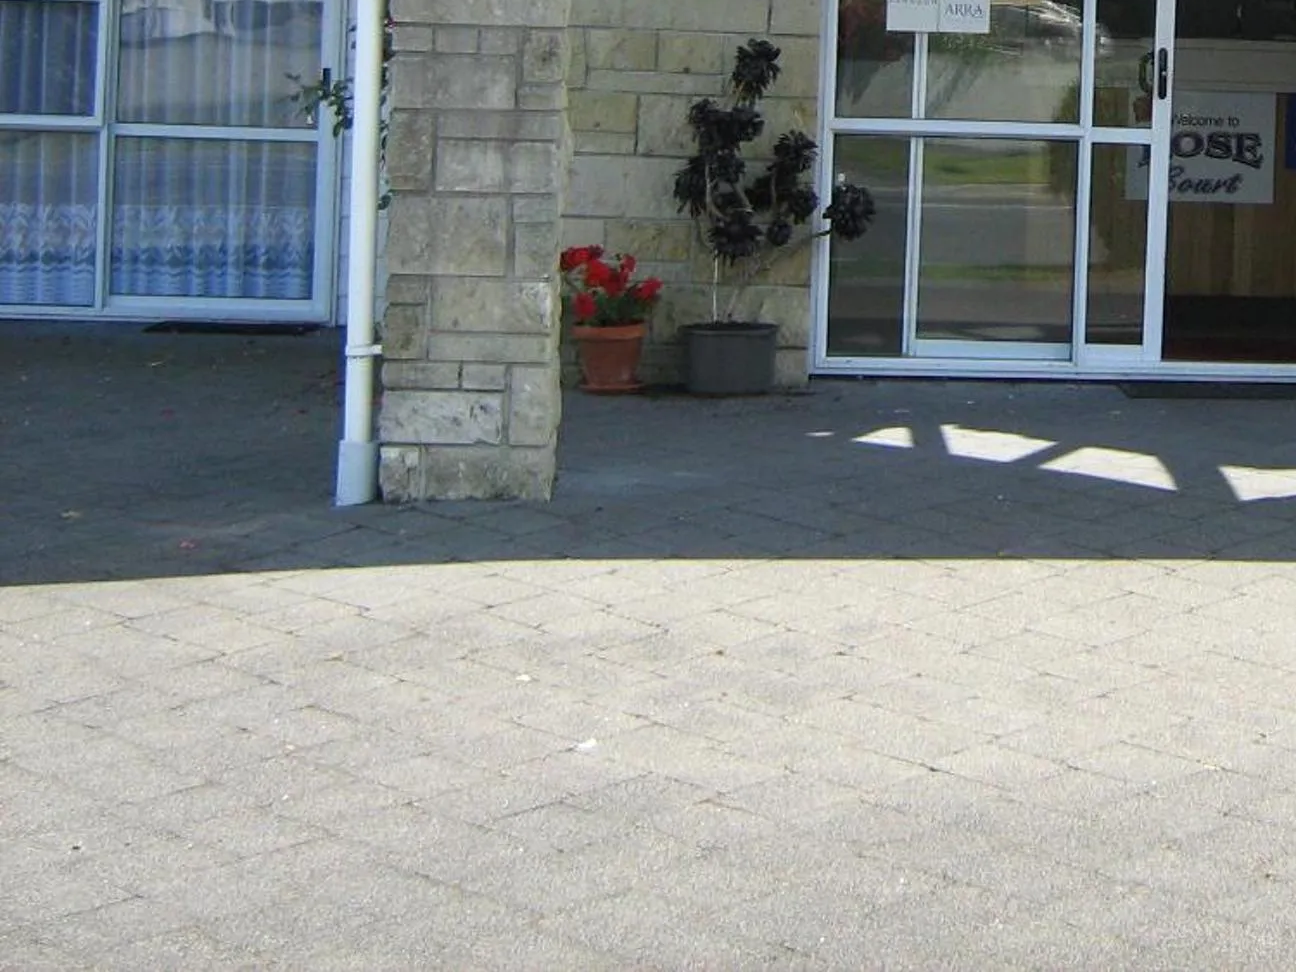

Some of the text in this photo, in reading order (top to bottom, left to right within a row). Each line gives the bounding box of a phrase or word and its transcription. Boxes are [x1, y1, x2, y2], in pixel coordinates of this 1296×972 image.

[944, 3, 984, 18] ARRA
[1228, 115, 1240, 127] to
[1138, 130, 1264, 170] OSE
